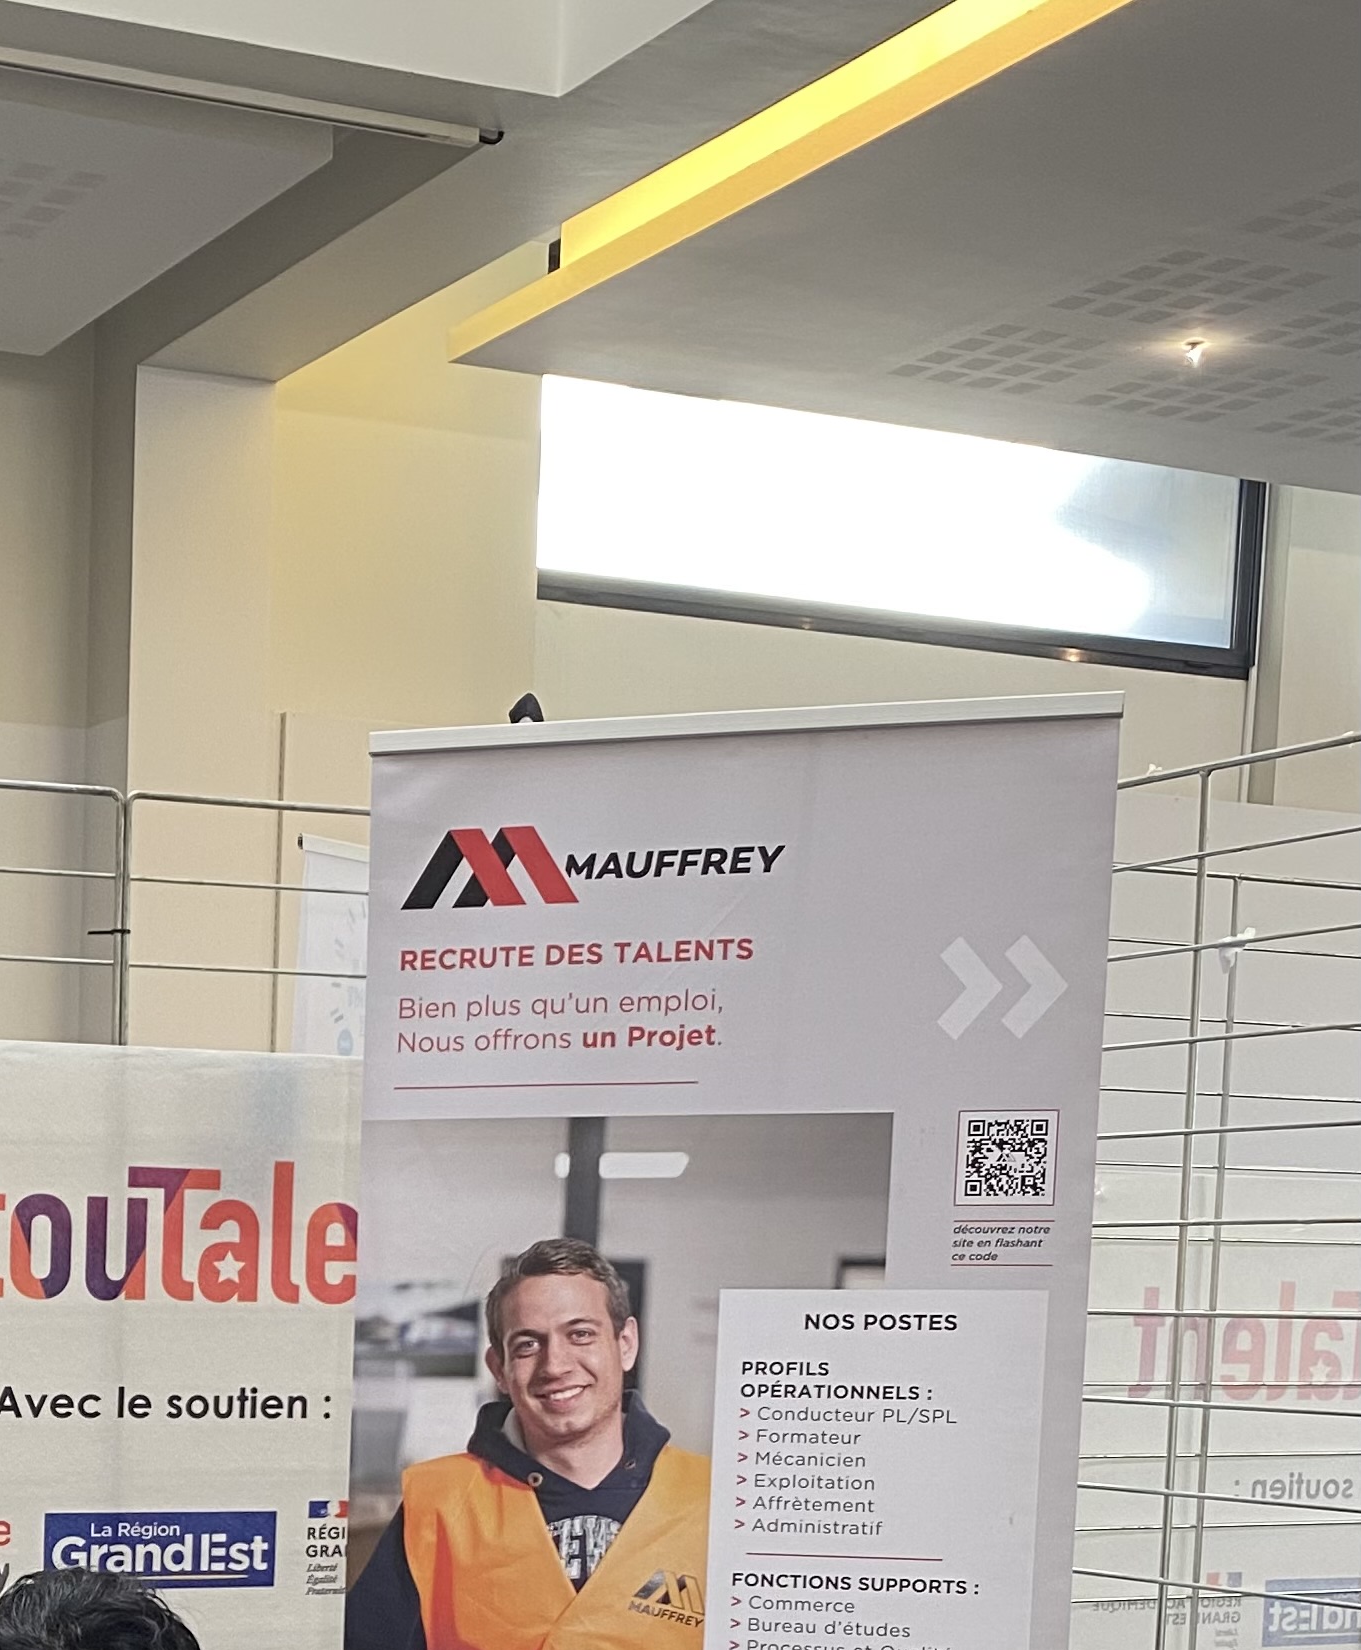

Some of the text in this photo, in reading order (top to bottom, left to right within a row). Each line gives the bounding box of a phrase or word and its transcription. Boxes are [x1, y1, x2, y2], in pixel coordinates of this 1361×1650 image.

[564, 844, 786, 881] MAUFFREY
[399, 937, 755, 972] RECRUTE DES TALENTS
[398, 996, 457, 1020] Bien
[467, 994, 521, 1023] plus
[618, 989, 725, 1020] emploi,
[396, 1025, 723, 1054] Nous offrons un Projet.
[952, 1224, 1051, 1235] découvrez notre
[951, 1238, 1044, 1248] site en flashant
[951, 1251, 999, 1261] ce code
[804, 1313, 958, 1331] NOS POSTES
[741, 1361, 830, 1377] PROFILS
[740, 1380, 920, 1400] OPÉRATIONNELS
[117, 1386, 152, 1419] le
[167, 1386, 310, 1420] soutien
[757, 1406, 958, 1425] Conducteur PL/SPL
[756, 1429, 862, 1445] Formateur
[755, 1451, 867, 1468] Mécanicien
[754, 1473, 876, 1492] Exploitation
[752, 1496, 876, 1513] Affrètement
[90, 1521, 180, 1540] La Région
[307, 1524, 346, 1540] RÉGI
[751, 1518, 884, 1536] Administratif
[305, 1544, 346, 1558] GRA
[731, 1572, 852, 1591] FONCTIONS
[858, 1577, 968, 1595] SUPPORTS
[748, 1595, 856, 1614] Commerce
[628, 1600, 705, 1628] MAUFFREY
[747, 1618, 816, 1635] Bureau
